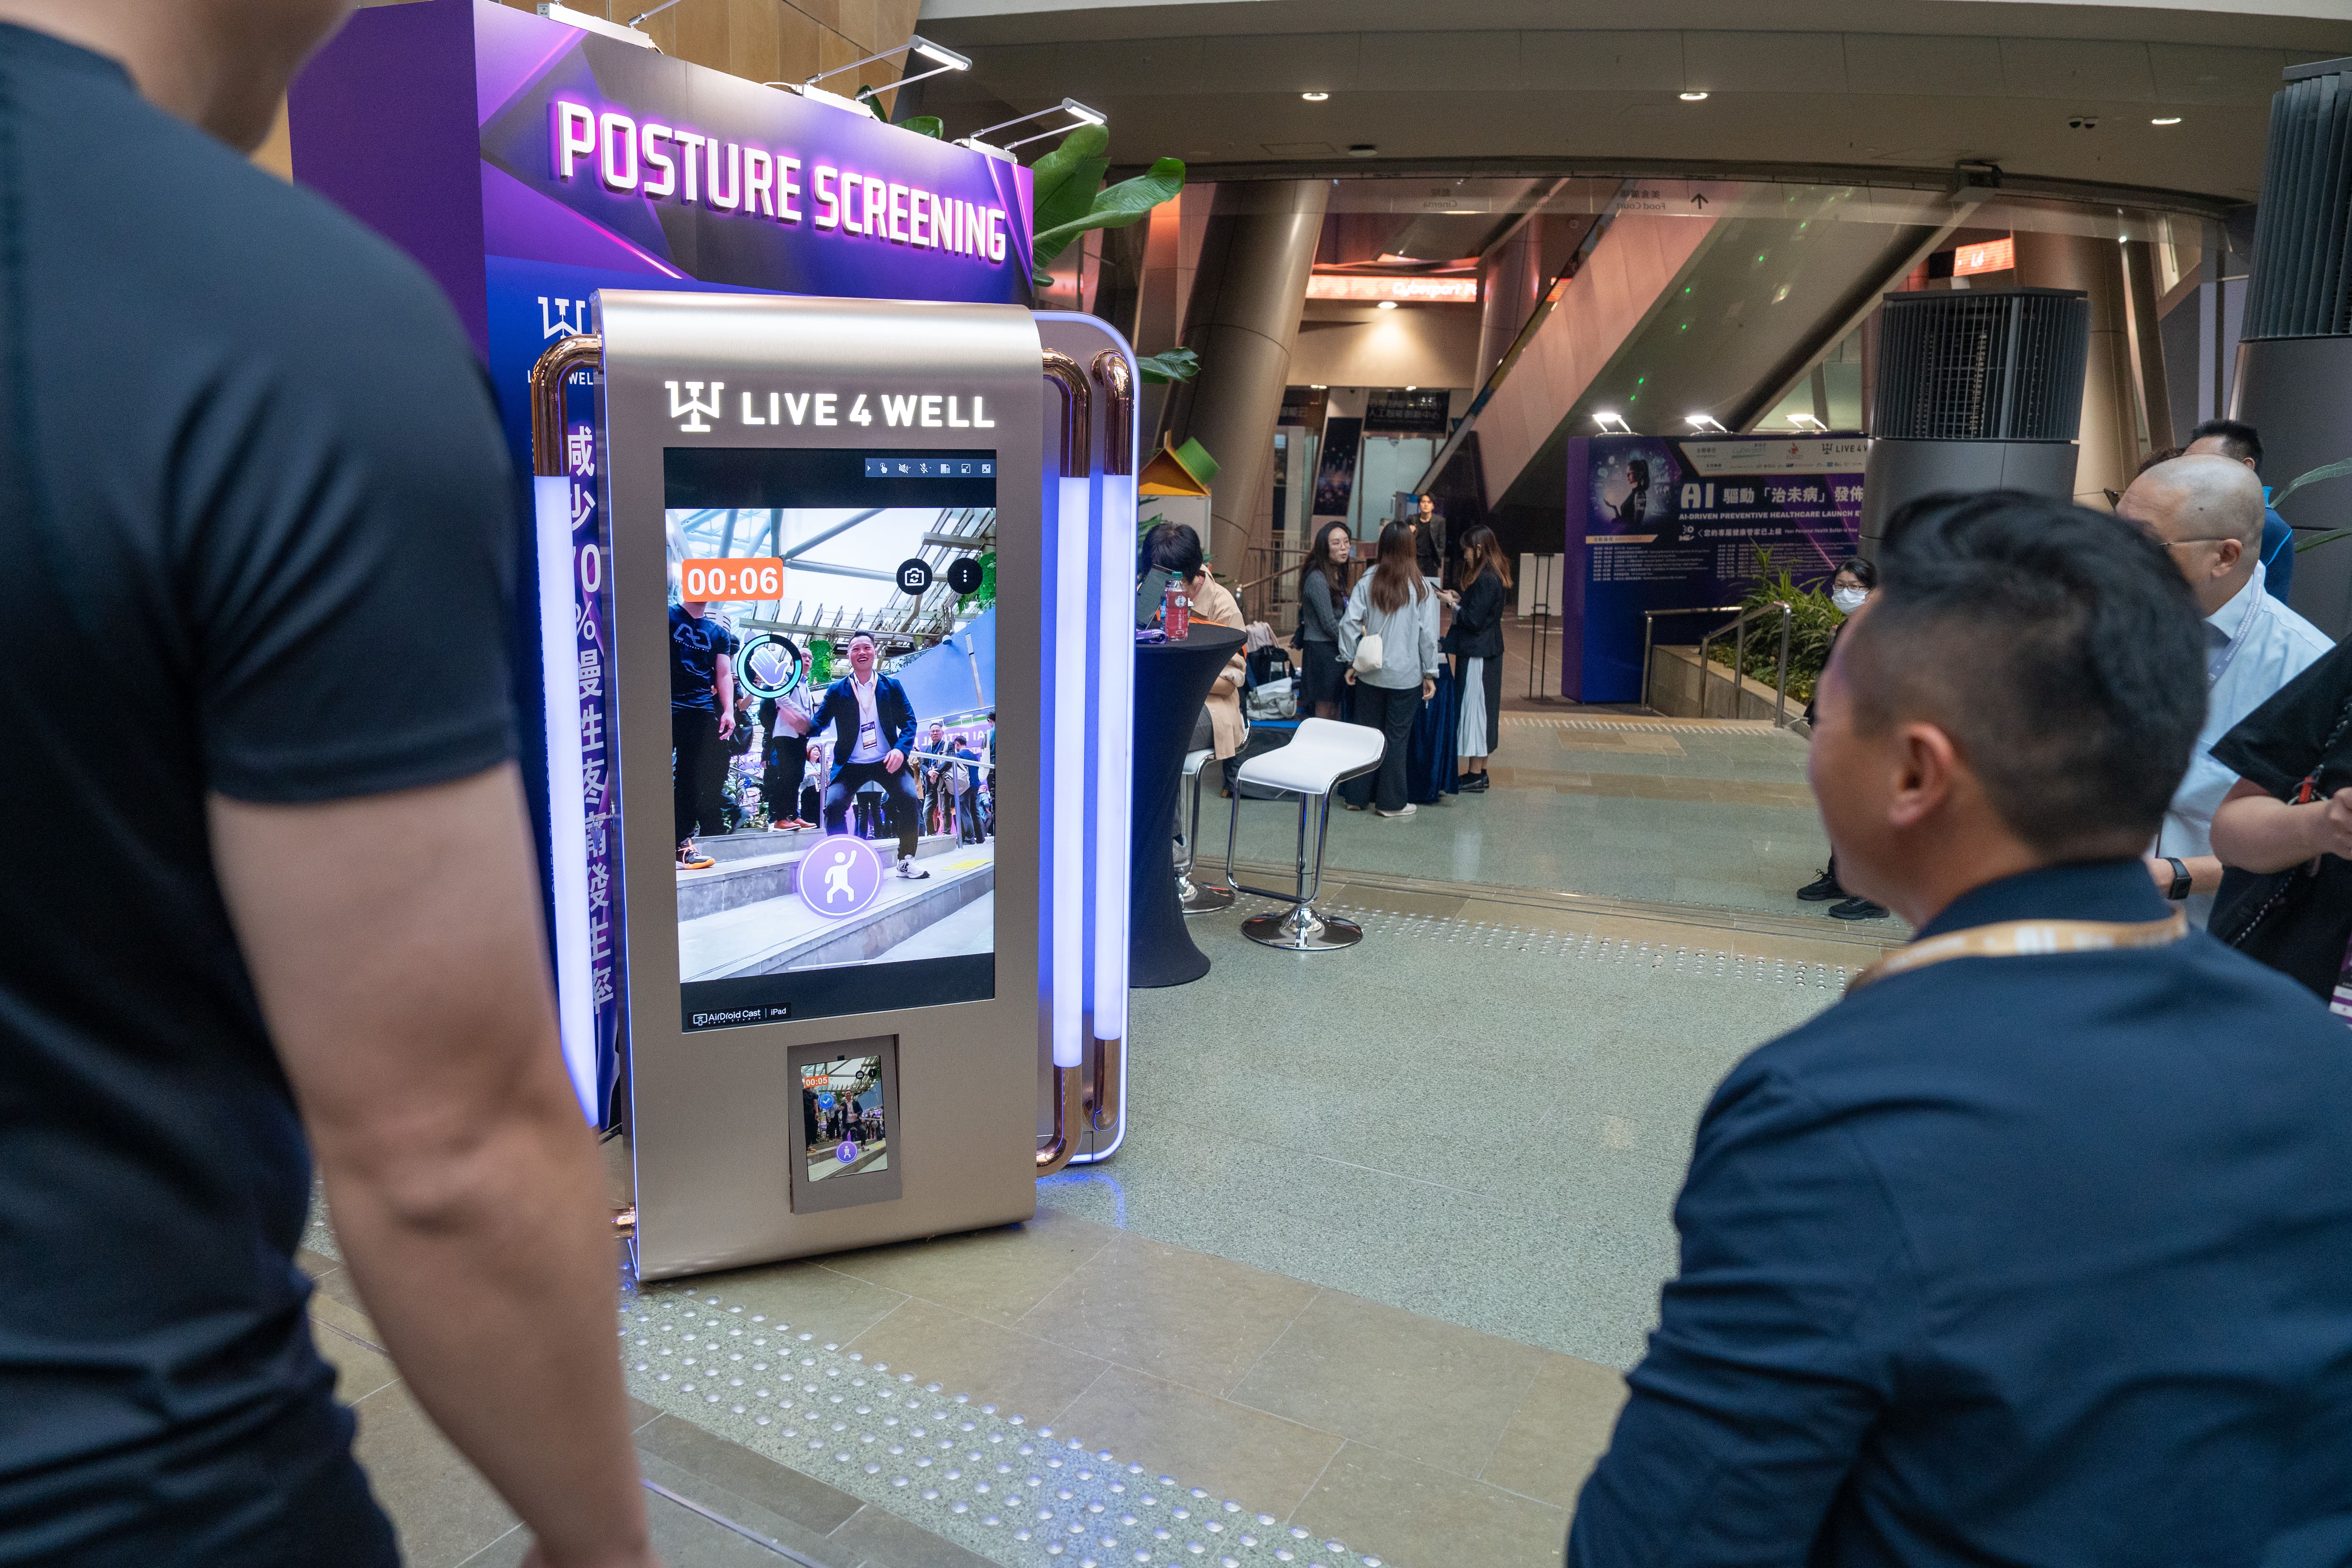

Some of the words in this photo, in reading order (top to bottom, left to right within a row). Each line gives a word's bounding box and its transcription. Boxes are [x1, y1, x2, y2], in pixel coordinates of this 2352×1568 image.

[558, 101, 802, 221] POSTURE
[815, 166, 1005, 261] SCREENING
[1971, 250, 1984, 267] L4
[1392, 281, 1462, 298] Cyberport
[743, 392, 837, 425] LIVE
[850, 394, 872, 426] 4
[882, 395, 994, 427] WELL
[1680, 483, 1714, 509] AI
[688, 567, 778, 595] 00:06
[708, 1011, 741, 1021] AirDroid
[743, 1009, 761, 1017] Cast
[806, 1077, 828, 1086] 00:05
